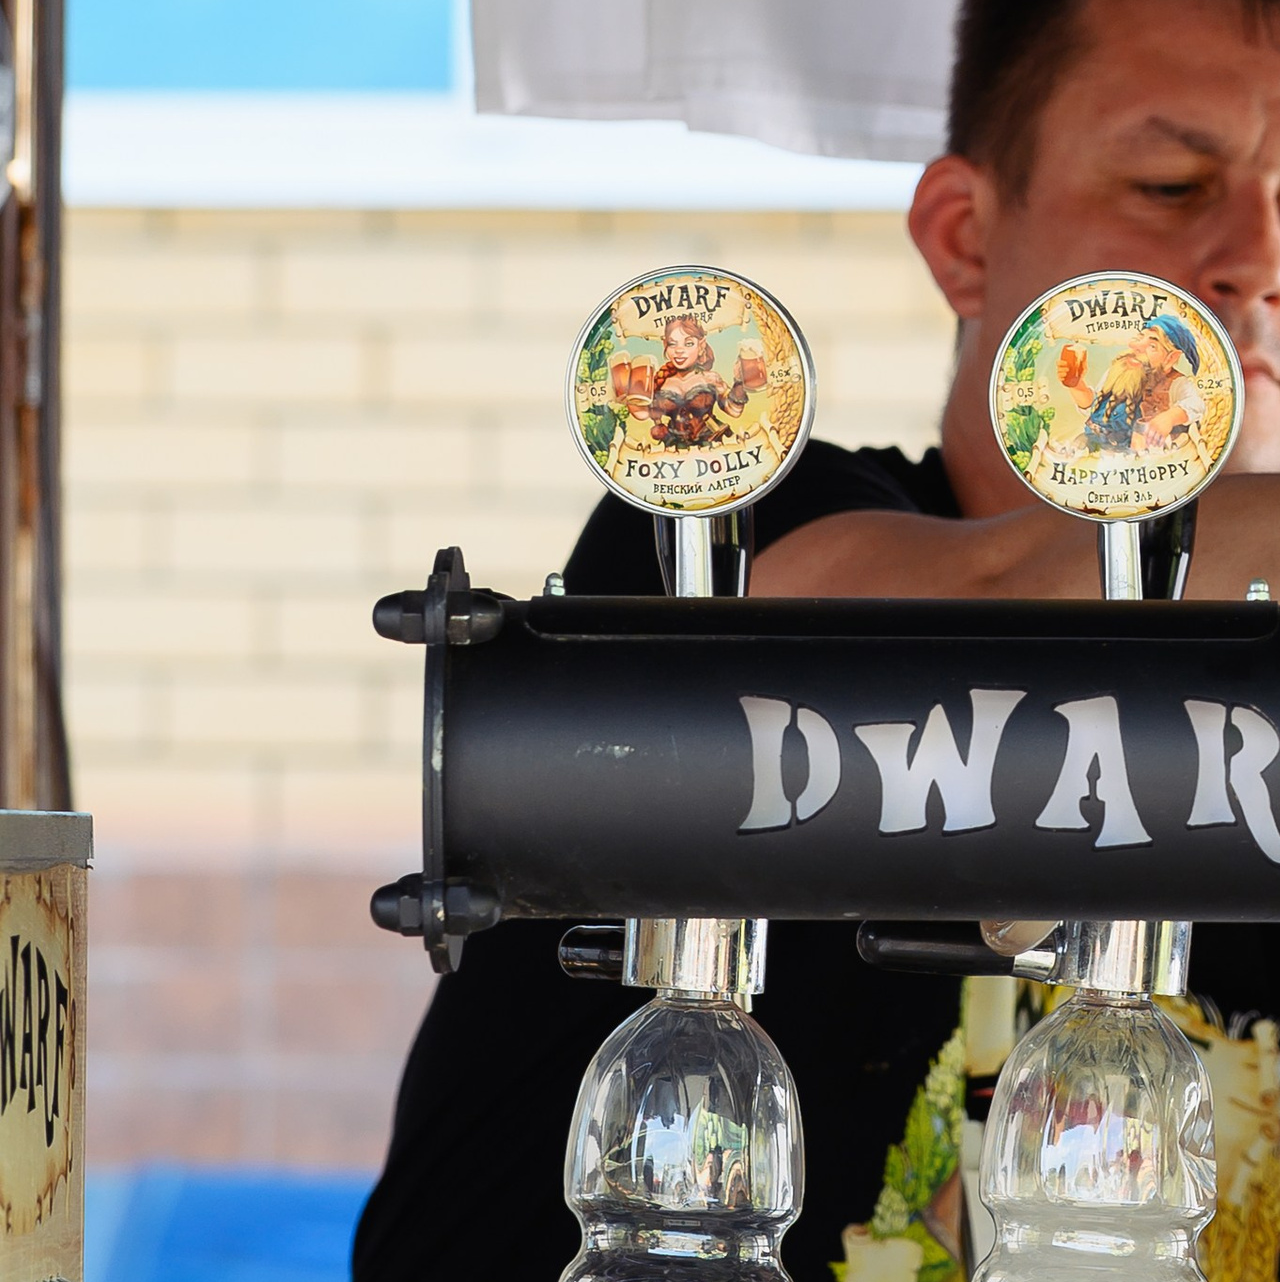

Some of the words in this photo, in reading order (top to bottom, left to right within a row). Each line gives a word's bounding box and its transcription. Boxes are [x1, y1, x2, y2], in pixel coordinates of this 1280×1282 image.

[631, 284, 730, 319] DWARF
[1064, 290, 1168, 323] DWARF
[590, 386, 607, 398] 0,5
[1017, 387, 1034, 398] 0,5
[625, 459, 685, 479] FOXY
[695, 445, 763, 478] DOLLY
[653, 482, 703, 495] ВЕНСКИЙ
[708, 475, 741, 492] ЛАГЕР
